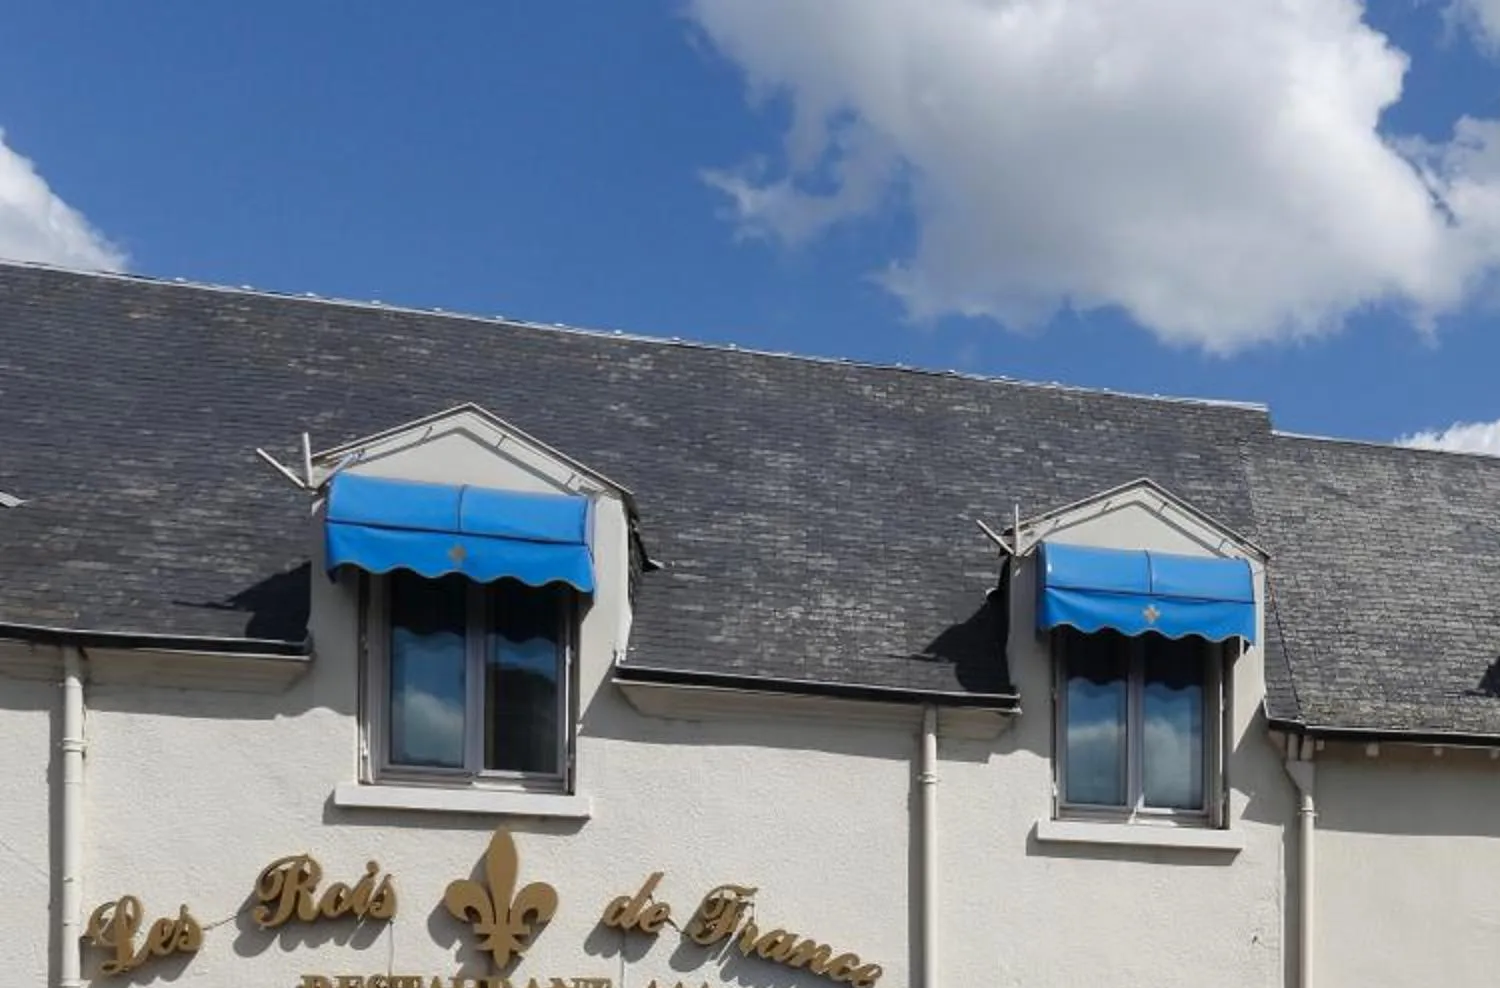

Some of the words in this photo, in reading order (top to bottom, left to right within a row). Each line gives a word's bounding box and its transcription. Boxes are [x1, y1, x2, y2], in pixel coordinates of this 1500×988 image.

[87, 895, 205, 975] Les
[254, 854, 398, 928] Rois
[603, 871, 665, 934] de
